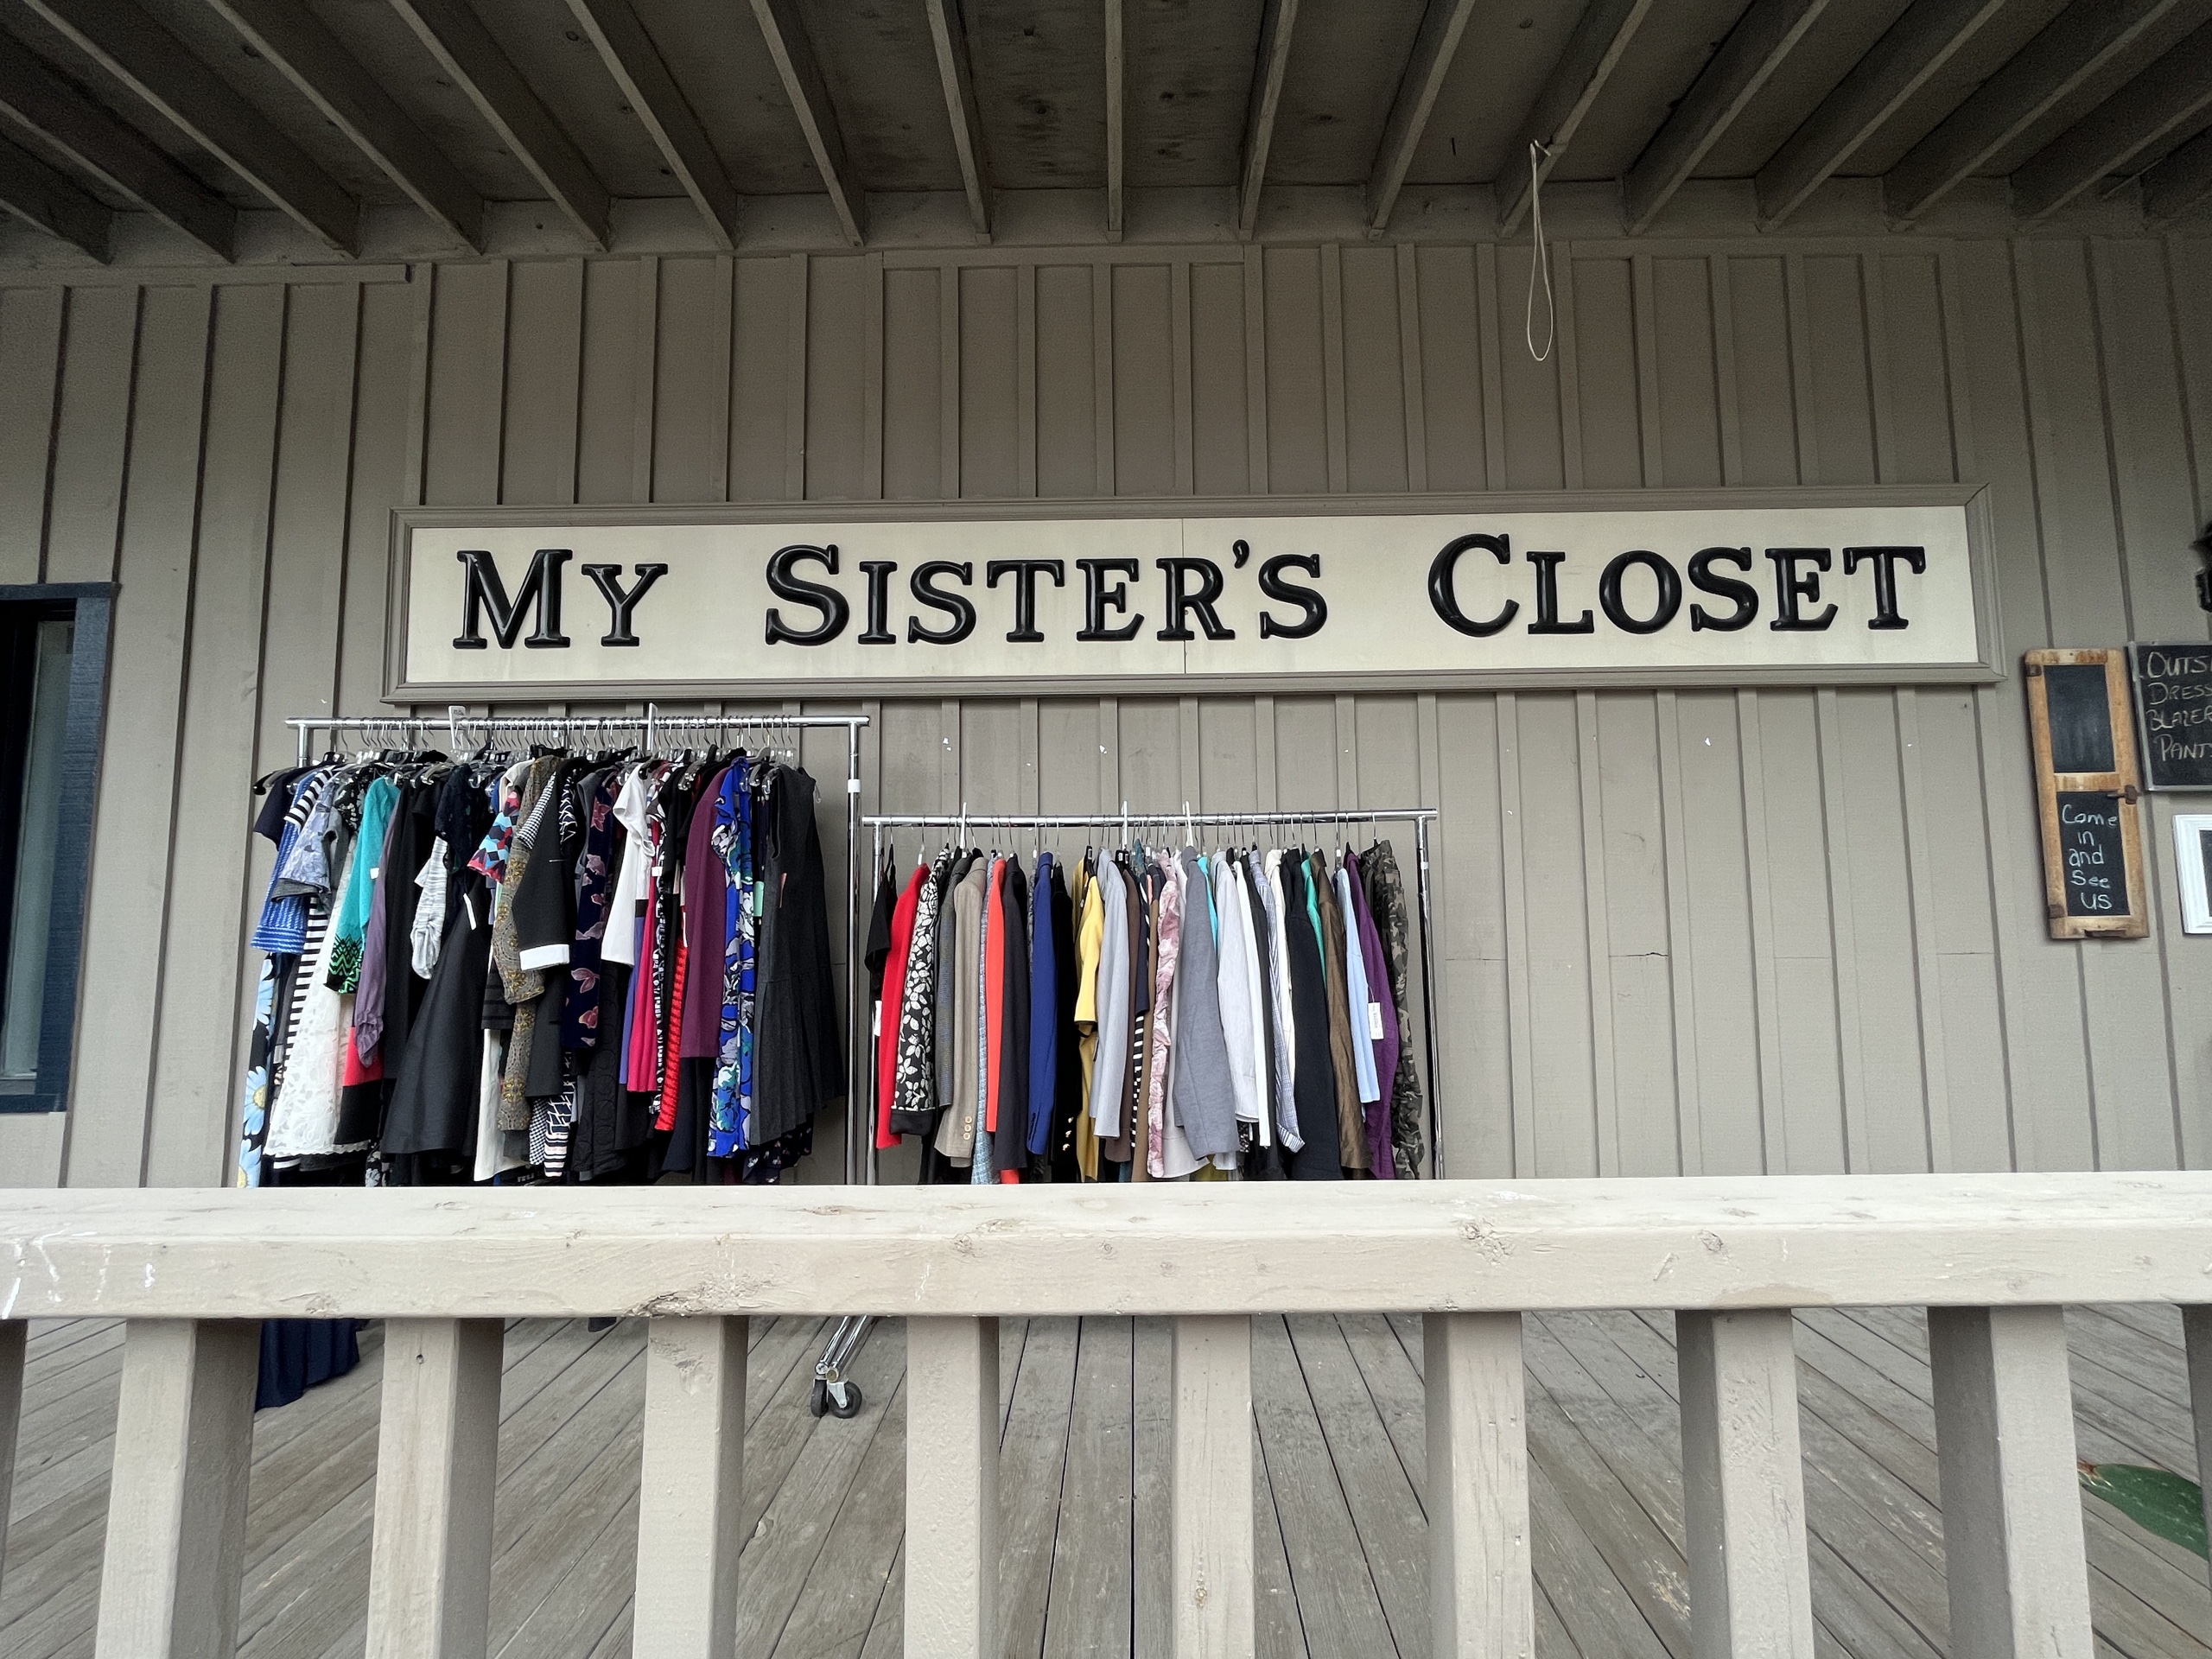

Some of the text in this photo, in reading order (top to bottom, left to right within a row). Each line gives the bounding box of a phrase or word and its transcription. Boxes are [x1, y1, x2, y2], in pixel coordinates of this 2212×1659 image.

[452, 533, 1927, 652] MY SISTER'S CLOSET
[2153, 734, 2212, 761] PANT
[2062, 804, 2118, 826] Come
[2077, 830, 2095, 846] in
[2069, 844, 2105, 867] and
